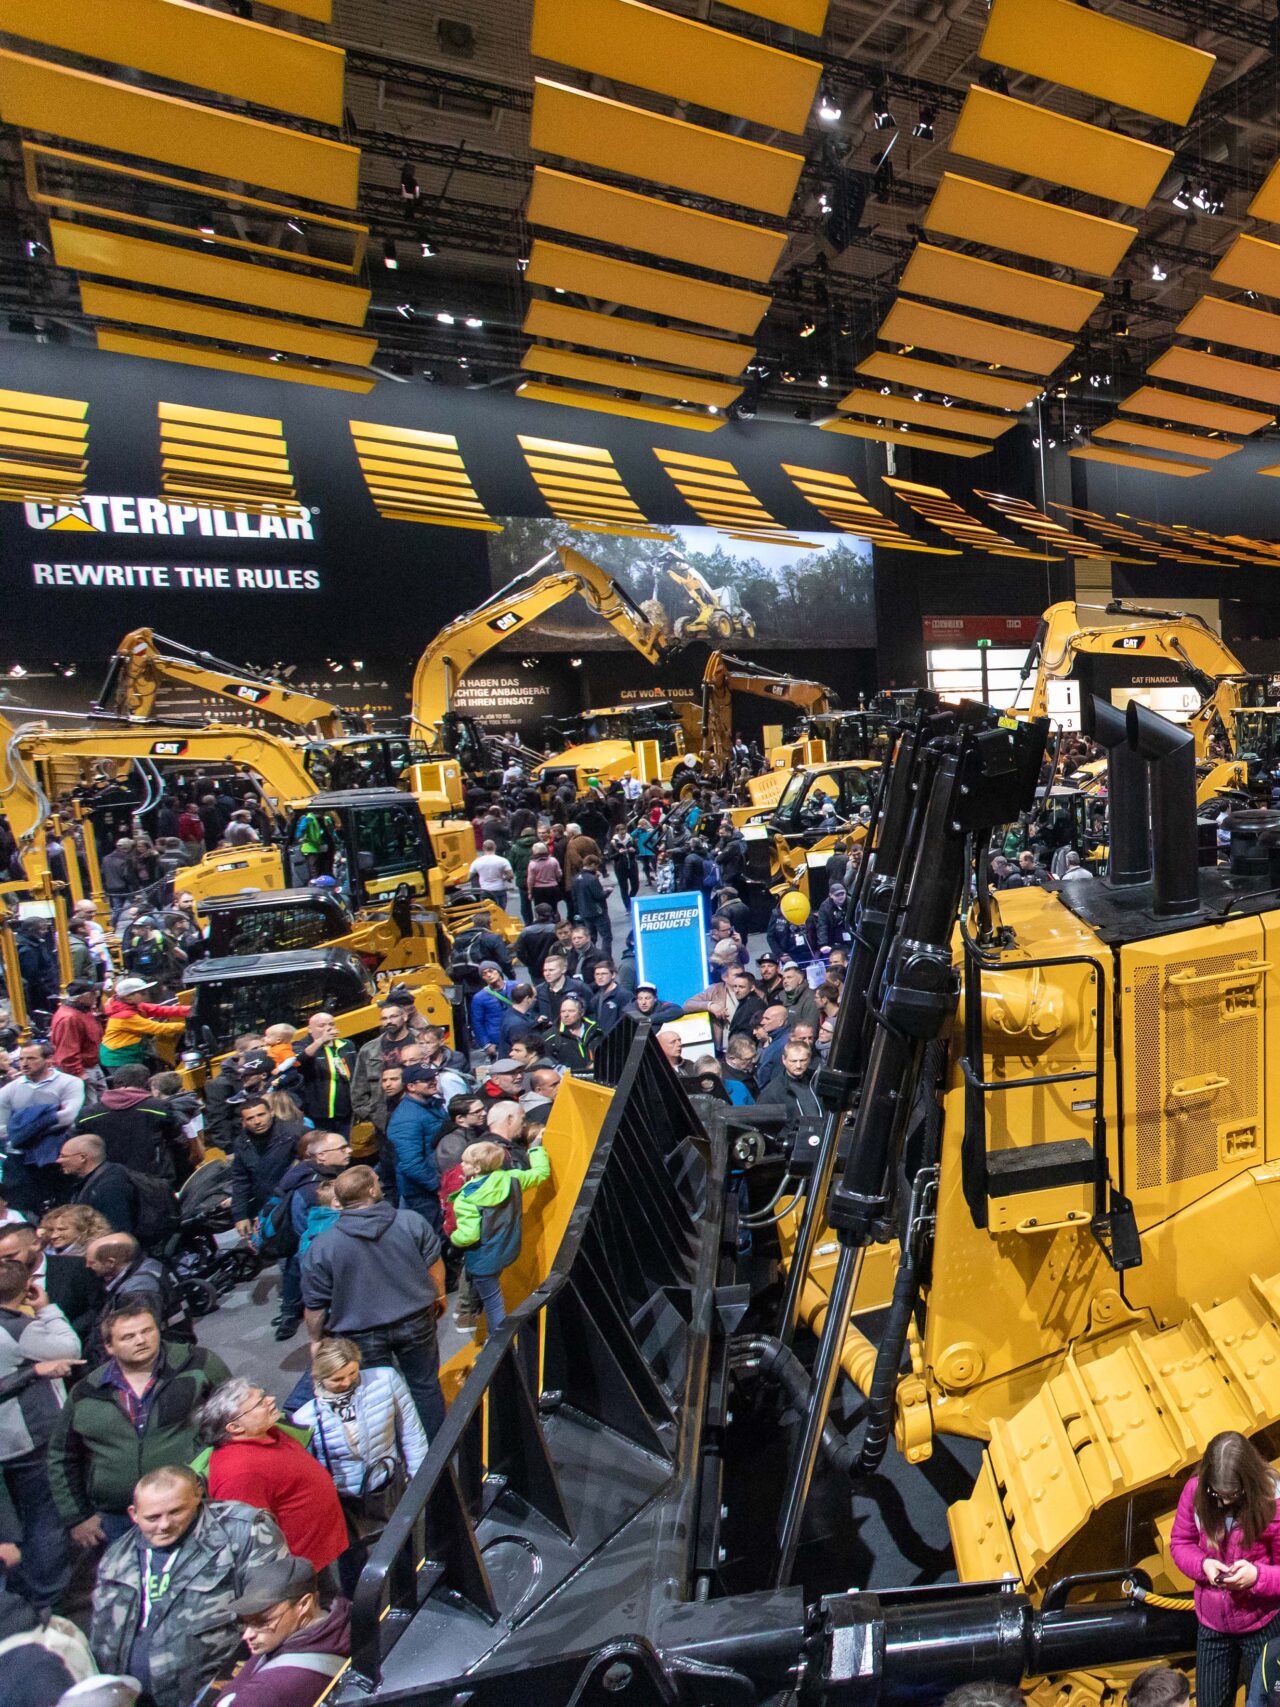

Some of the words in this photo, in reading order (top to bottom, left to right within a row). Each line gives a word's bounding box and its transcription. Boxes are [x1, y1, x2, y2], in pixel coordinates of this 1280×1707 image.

[32, 563, 171, 587] REWRITE
[174, 566, 231, 588] THE
[236, 568, 321, 589] RULES
[496, 612, 518, 630] CAT
[1123, 638, 1138, 648] CAT
[468, 679, 499, 687] HABEN
[501, 679, 519, 687] DAS
[237, 686, 260, 702] CAT
[491, 686, 550, 696] ANBAUGERÄT
[620, 689, 637, 698] CAT
[667, 688, 694, 697] TOOLS
[772, 685, 784, 696] CAT
[1066, 687, 1072, 705] i
[468, 698, 496, 706] IHREN
[497, 697, 534, 706] EINSATZ
[1067, 718, 1073, 728] 3
[156, 742, 179, 754] CAT
[641, 909, 699, 922] ELECTRIFIED
[640, 918, 691, 931] PRODUCTS
